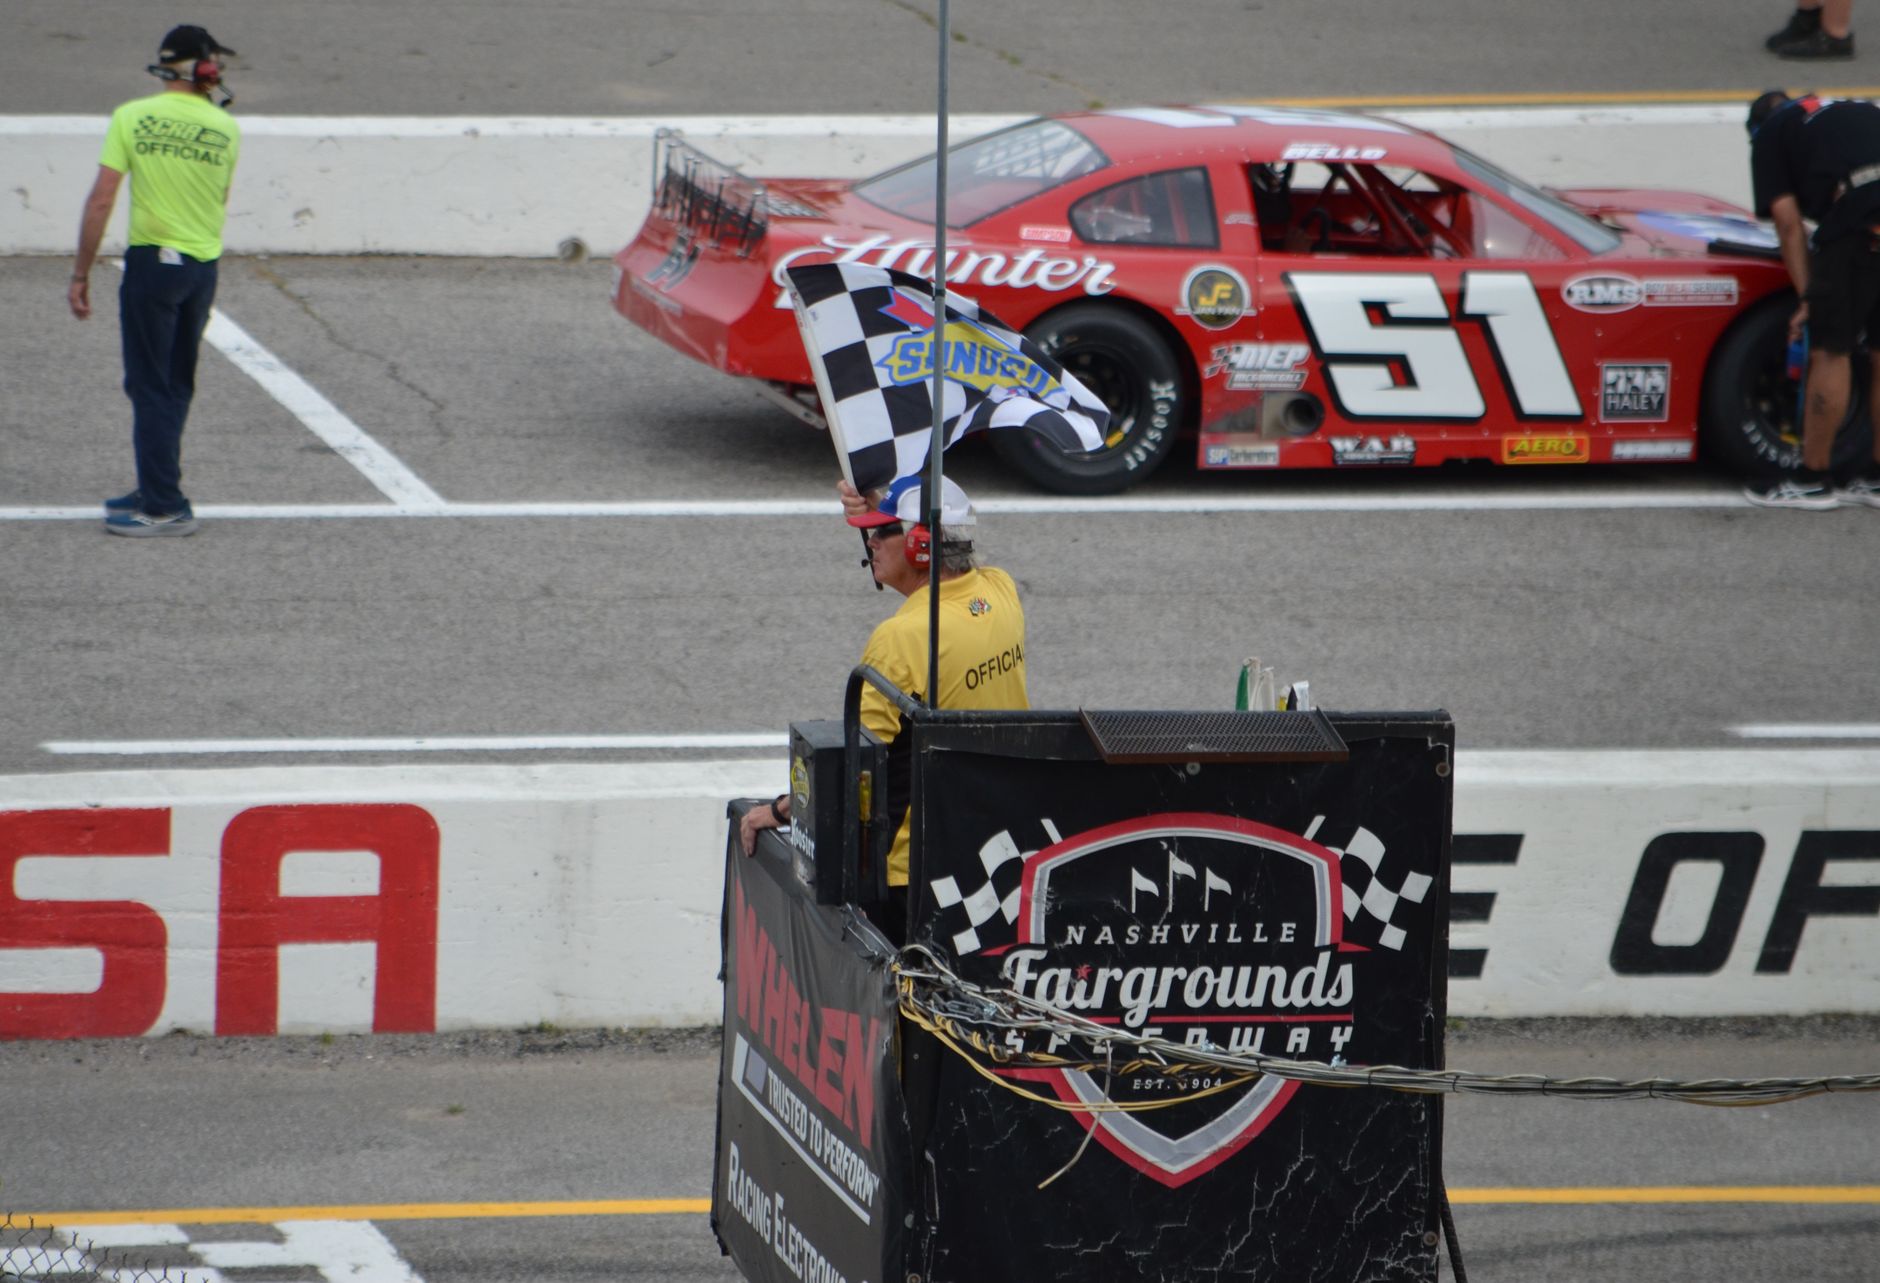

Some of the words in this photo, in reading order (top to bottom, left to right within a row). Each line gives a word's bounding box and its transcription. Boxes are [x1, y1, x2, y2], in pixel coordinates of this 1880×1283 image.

[135, 141, 223, 166] OFFICIAL
[1283, 148, 1388, 160] BELLO
[772, 234, 1117, 296] Hunter
[1570, 285, 1640, 305] RMS
[1282, 270, 1585, 422] 51
[1123, 379, 1177, 471] Hoosier
[1606, 394, 1664, 411] HALEY
[1513, 438, 1577, 454] AERO
[965, 643, 1024, 690] OFFICIA
[1609, 830, 1880, 977] OF
[1065, 922, 1297, 945] NASHVILLE
[735, 876, 880, 1150] WHELEN
[1003, 948, 1354, 1029] Fairgrounds
[1132, 1077, 1172, 1091] EST.
[1179, 1077, 1223, 1091] 904
[767, 1065, 808, 1142] TRUSTED
[809, 1111, 823, 1158] TO
[727, 1140, 772, 1245] RACING
